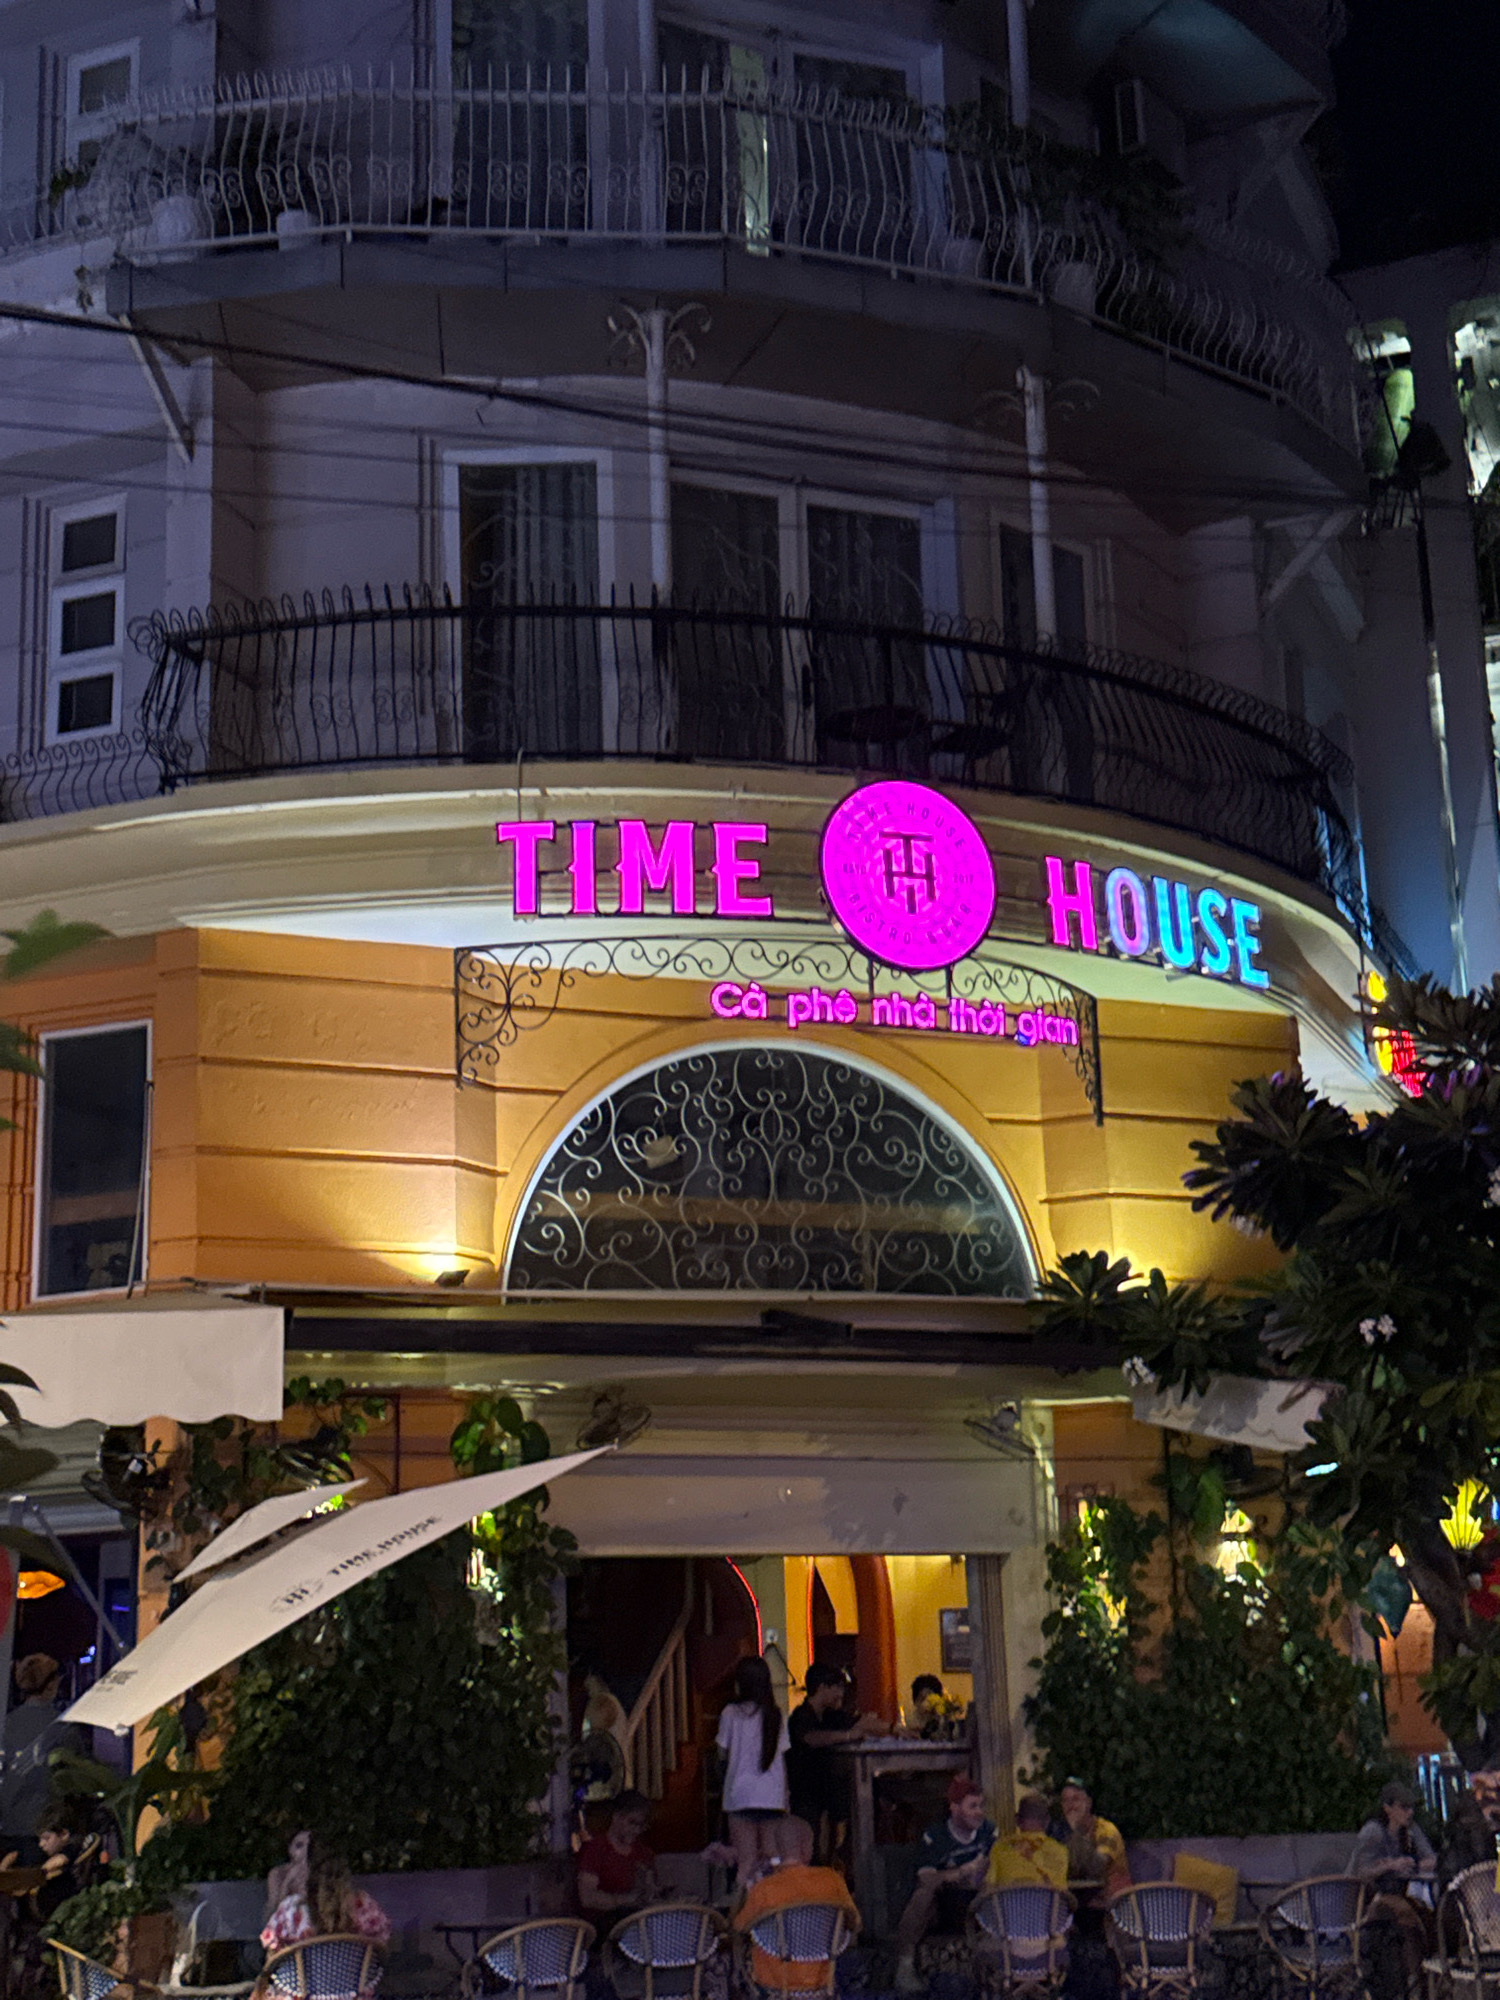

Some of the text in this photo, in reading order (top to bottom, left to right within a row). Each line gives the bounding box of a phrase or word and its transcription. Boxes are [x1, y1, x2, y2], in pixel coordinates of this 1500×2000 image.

[847, 800, 966, 849] TIME HOUSE
[496, 819, 1270, 989] TIME HOUSE
[849, 891, 911, 945] BISTRO
[940, 902, 972, 939] BAR
[710, 981, 768, 1019] Cà
[787, 986, 858, 1029] phê
[872, 991, 936, 1029] nhà
[1015, 1008, 1080, 1046] gian
